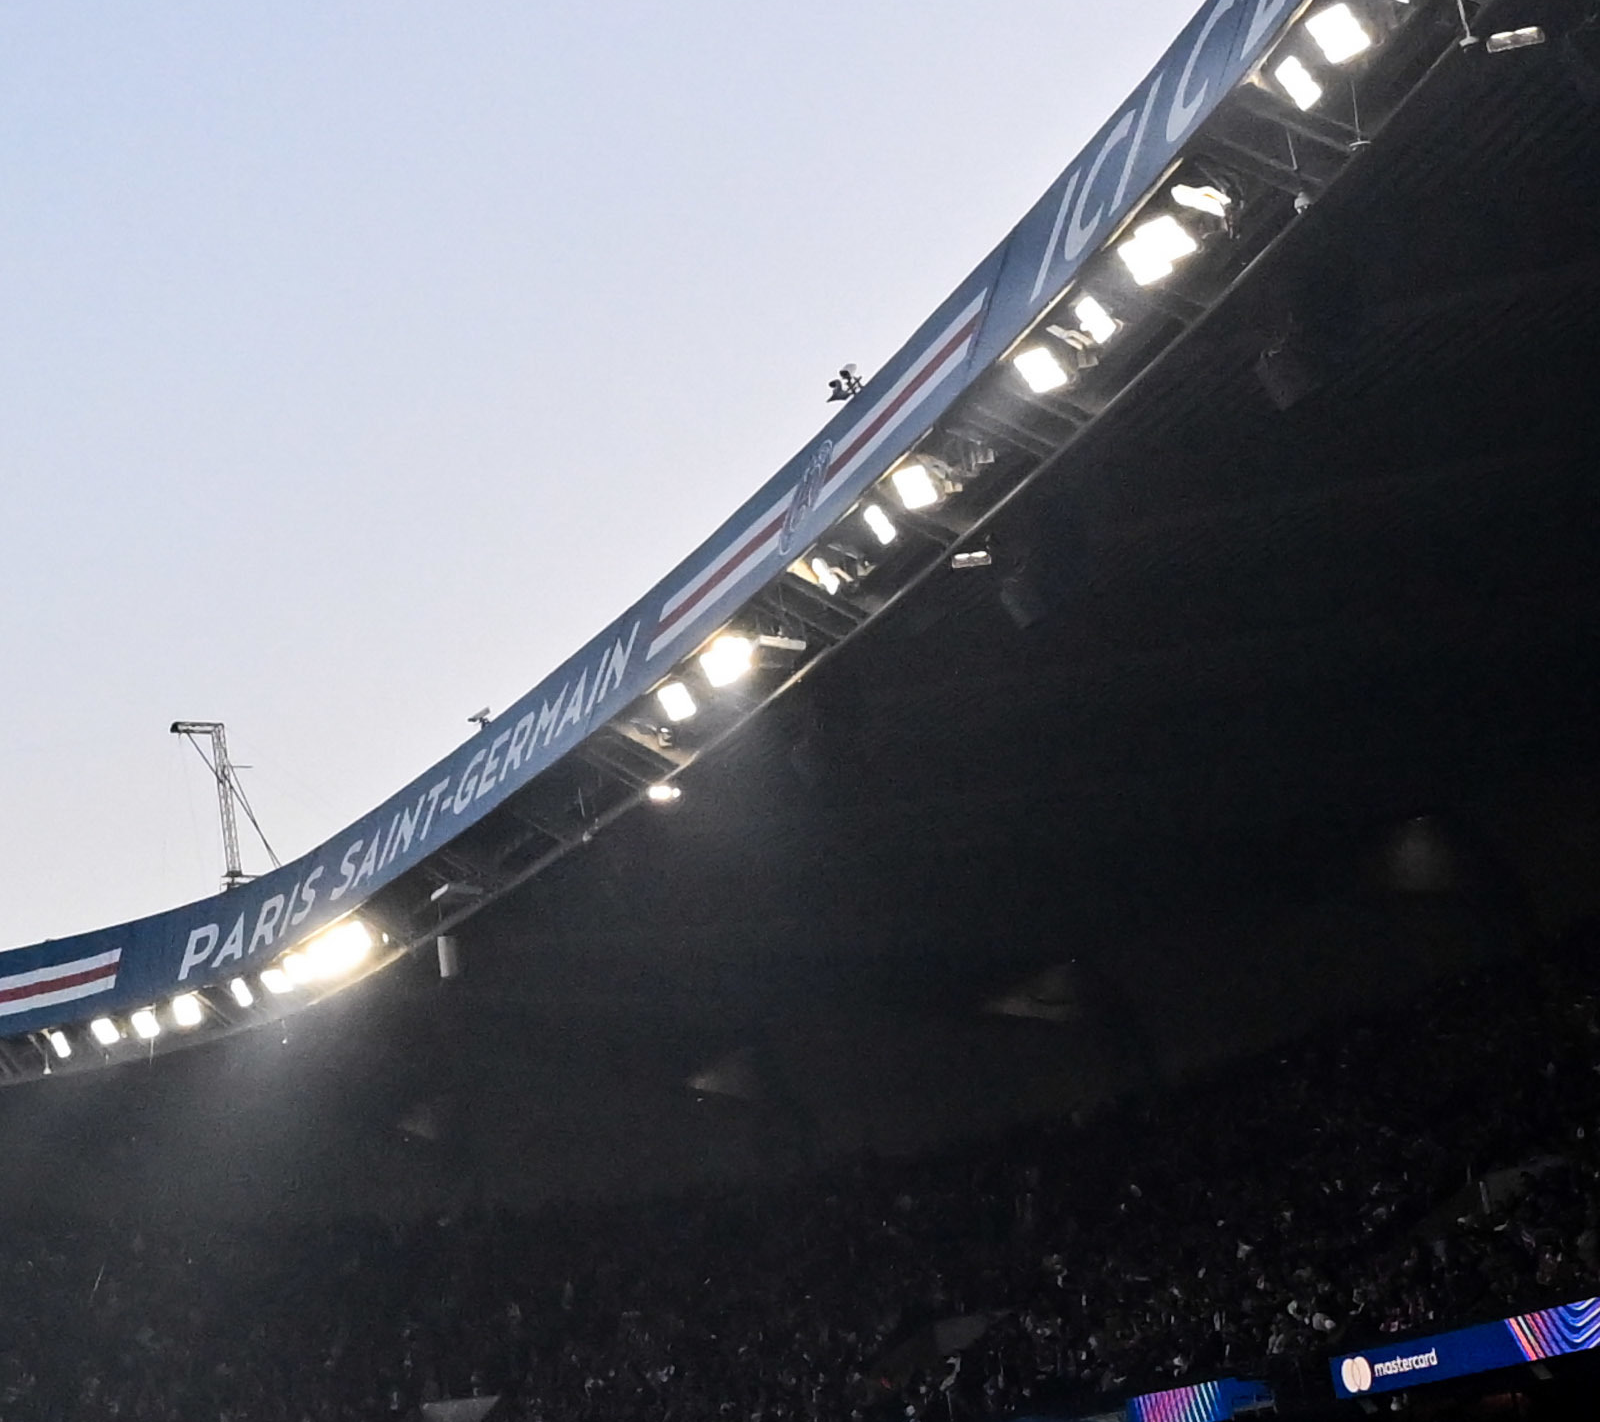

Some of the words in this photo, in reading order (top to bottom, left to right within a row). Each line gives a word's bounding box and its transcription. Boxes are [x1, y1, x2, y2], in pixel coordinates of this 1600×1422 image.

[1029, 73, 1162, 304] ICI
[177, 866, 324, 981] PARIS
[330, 620, 640, 901] SAINT-GERMAIN
[1373, 1347, 1438, 1377] mastercard
